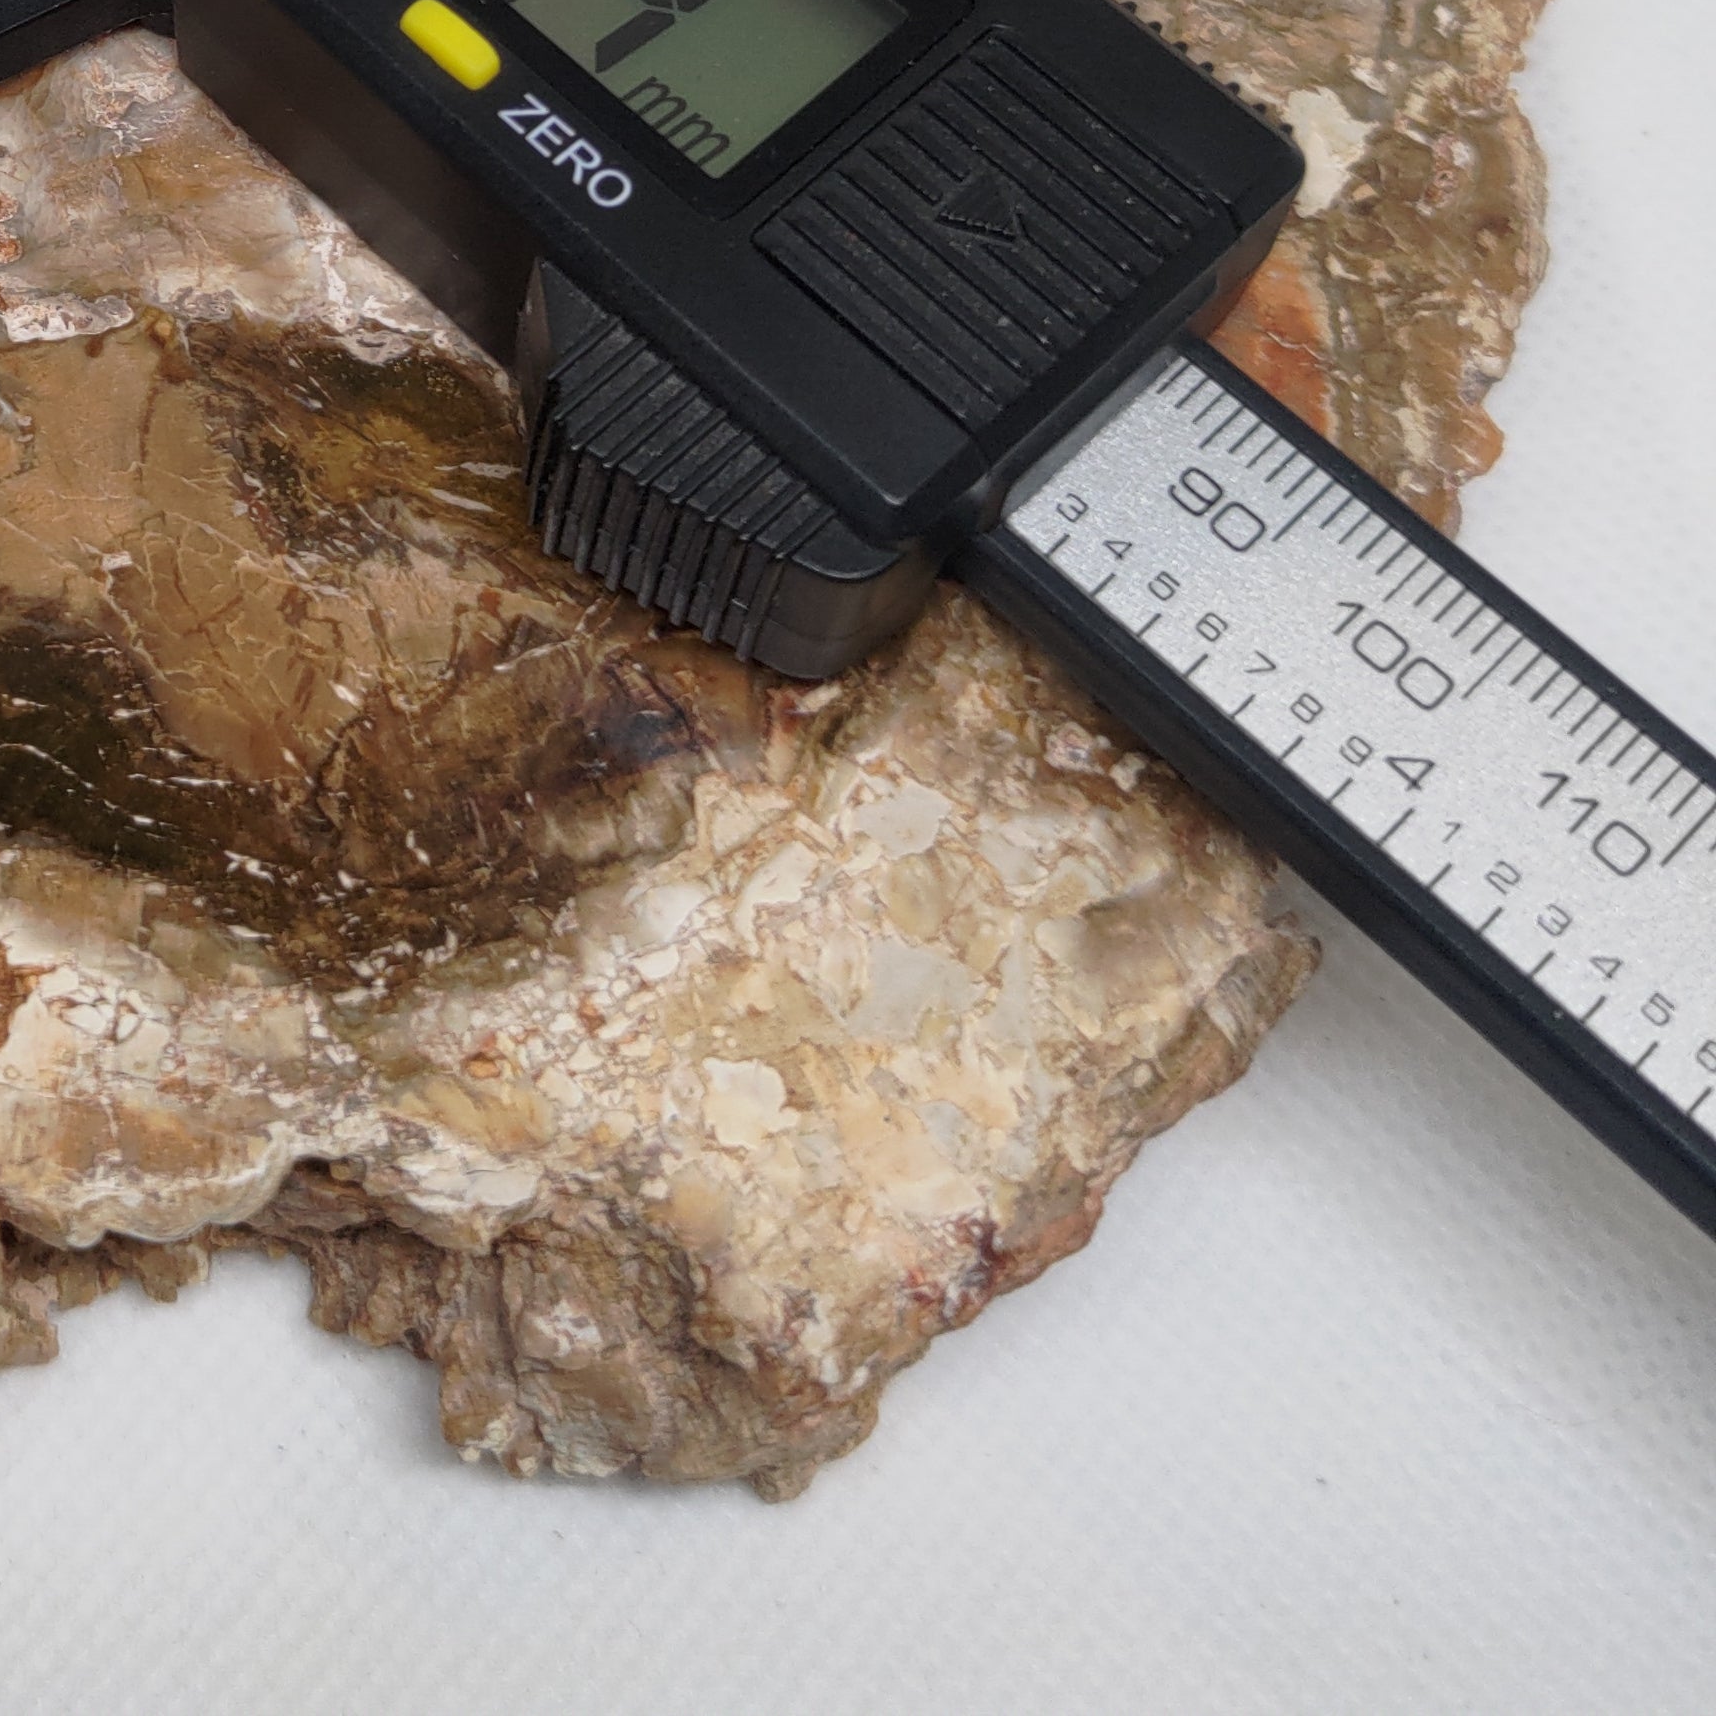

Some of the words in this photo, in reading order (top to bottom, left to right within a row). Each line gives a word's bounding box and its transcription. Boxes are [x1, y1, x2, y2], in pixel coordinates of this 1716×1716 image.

[496, 92, 633, 208] ZERO
[622, 75, 731, 167] mm
[1056, 492, 1089, 523] 3
[1102, 537, 1134, 561] 4
[1148, 571, 1180, 602] 5
[1195, 612, 1229, 642] 6
[1243, 650, 1277, 677] 7
[1290, 692, 1323, 724] 8
[1339, 735, 1373, 766] 9
[1384, 754, 1436, 792] 4
[1442, 820, 1463, 843] 1
[1484, 860, 1522, 894] 2
[1536, 903, 1571, 936] 3
[1589, 956, 1623, 979] 4
[1640, 992, 1675, 1026] 5
[1168, 466, 1266, 553] 90
[1332, 600, 1455, 711] 100
[1538, 771, 1652, 877] 110
